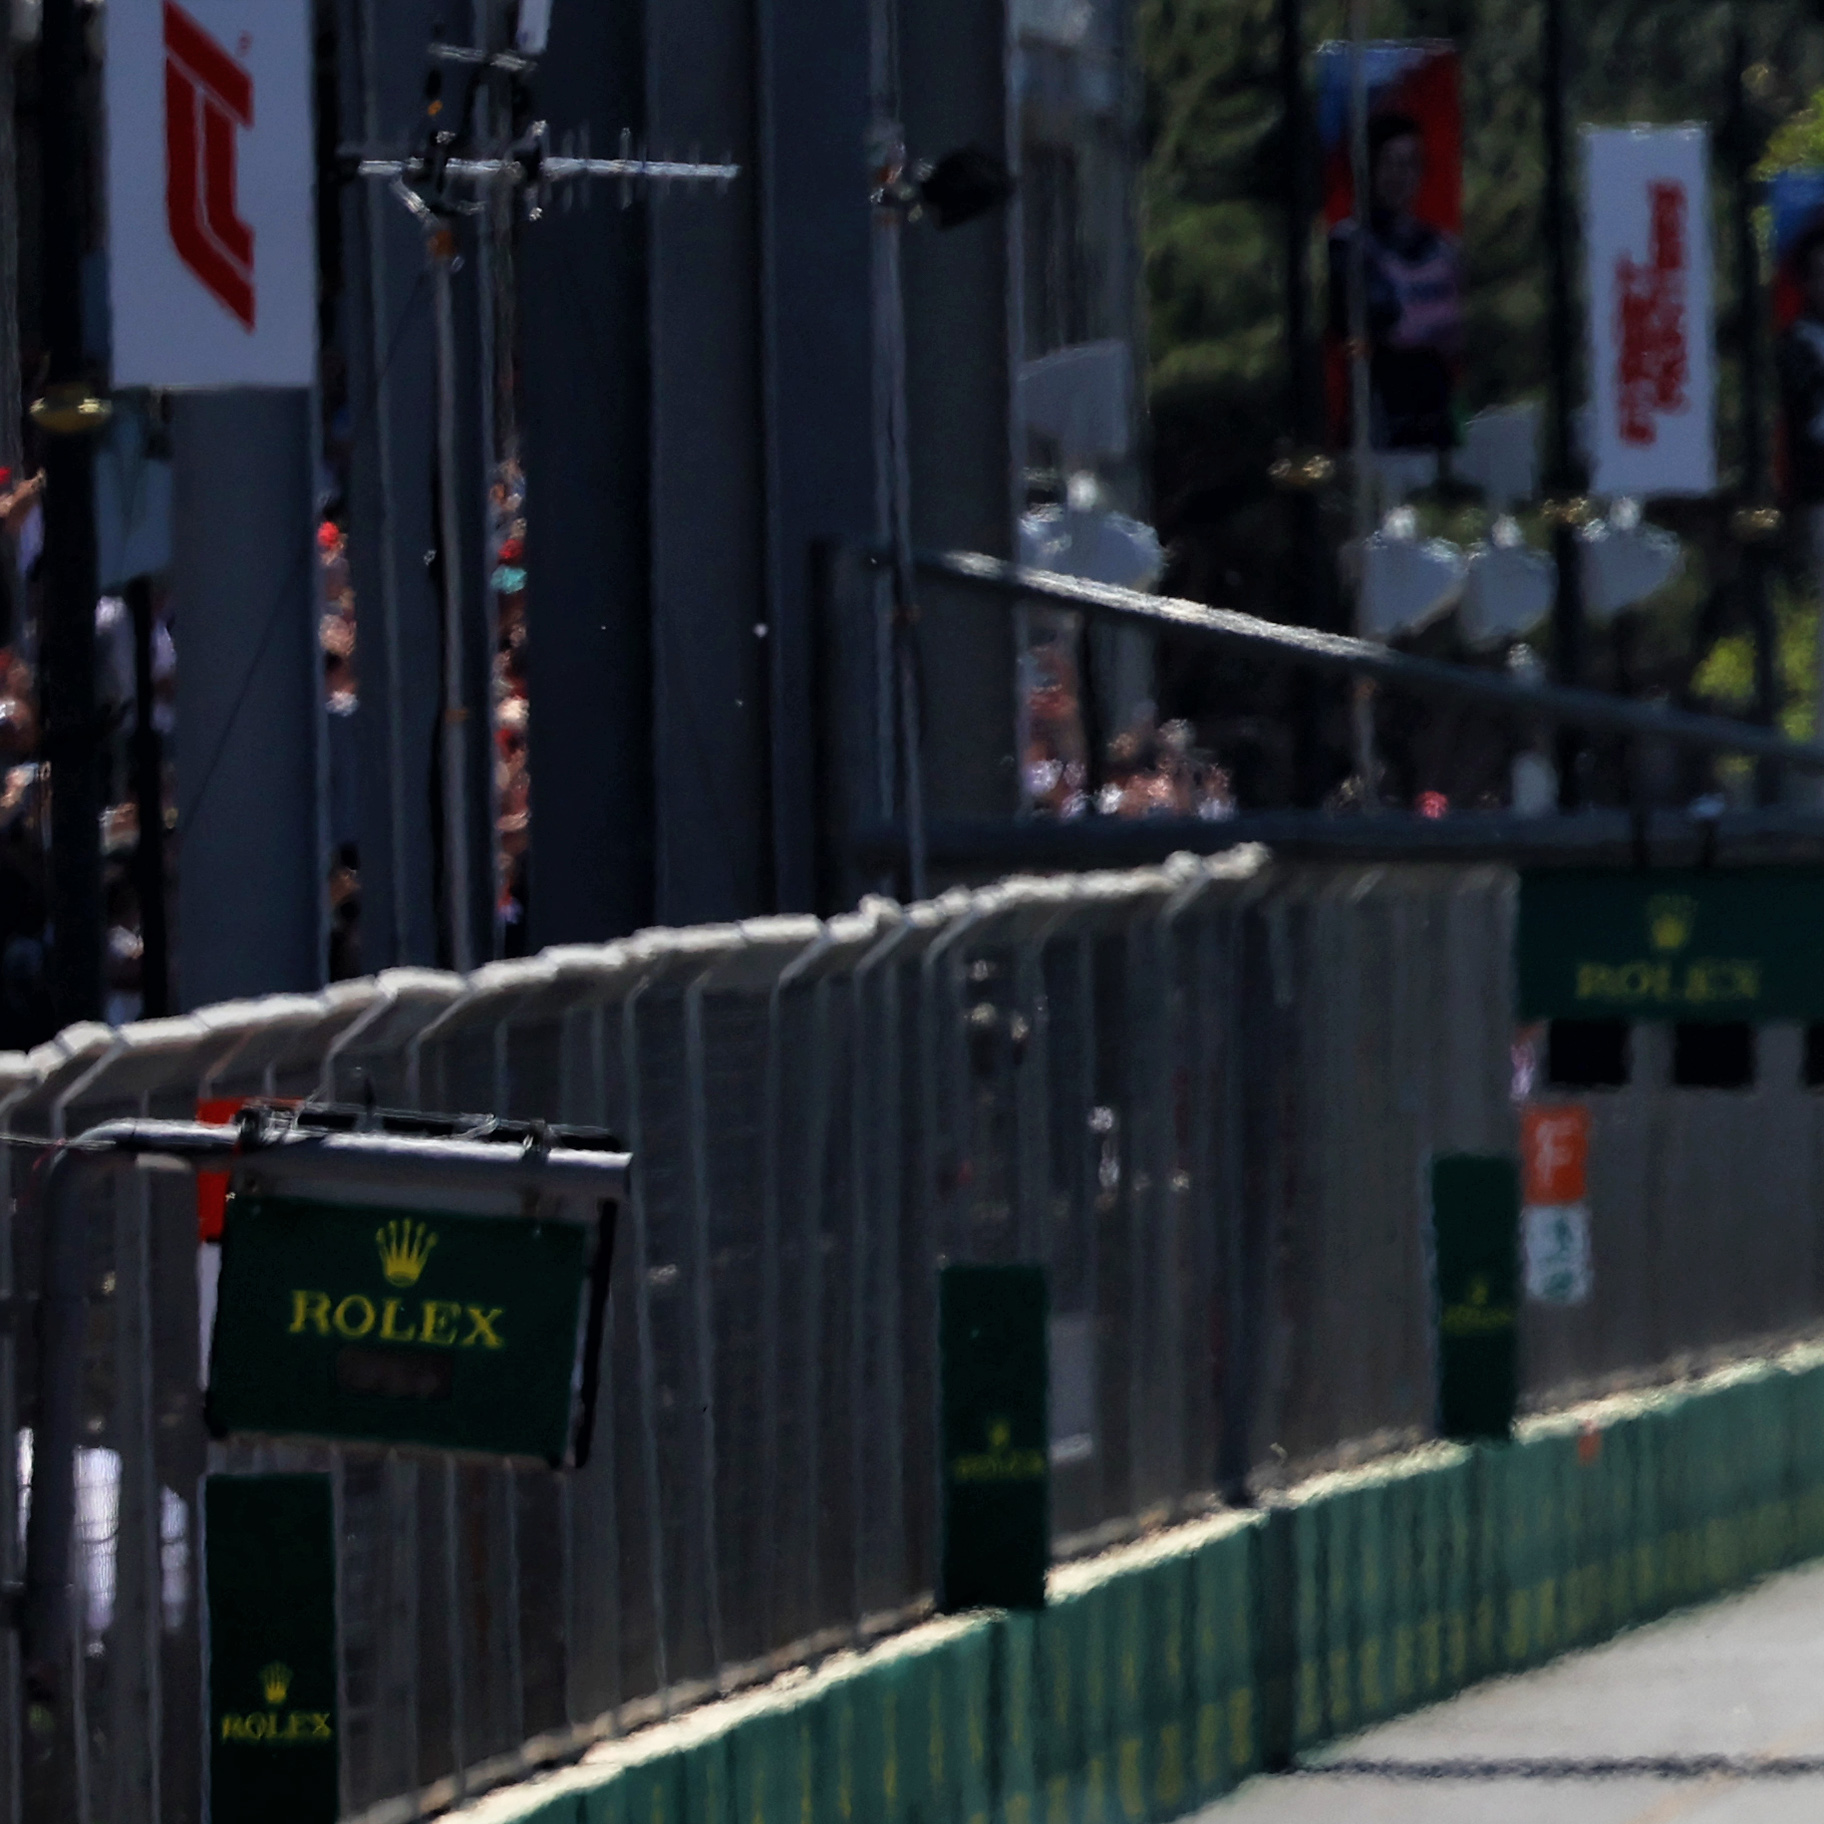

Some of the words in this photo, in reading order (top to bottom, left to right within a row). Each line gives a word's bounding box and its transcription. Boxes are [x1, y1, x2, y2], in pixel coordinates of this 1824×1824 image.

[1576, 958, 1761, 1001] ROLEX
[289, 1289, 504, 1349] ROLEX
[222, 1711, 331, 1742] ROLEX
